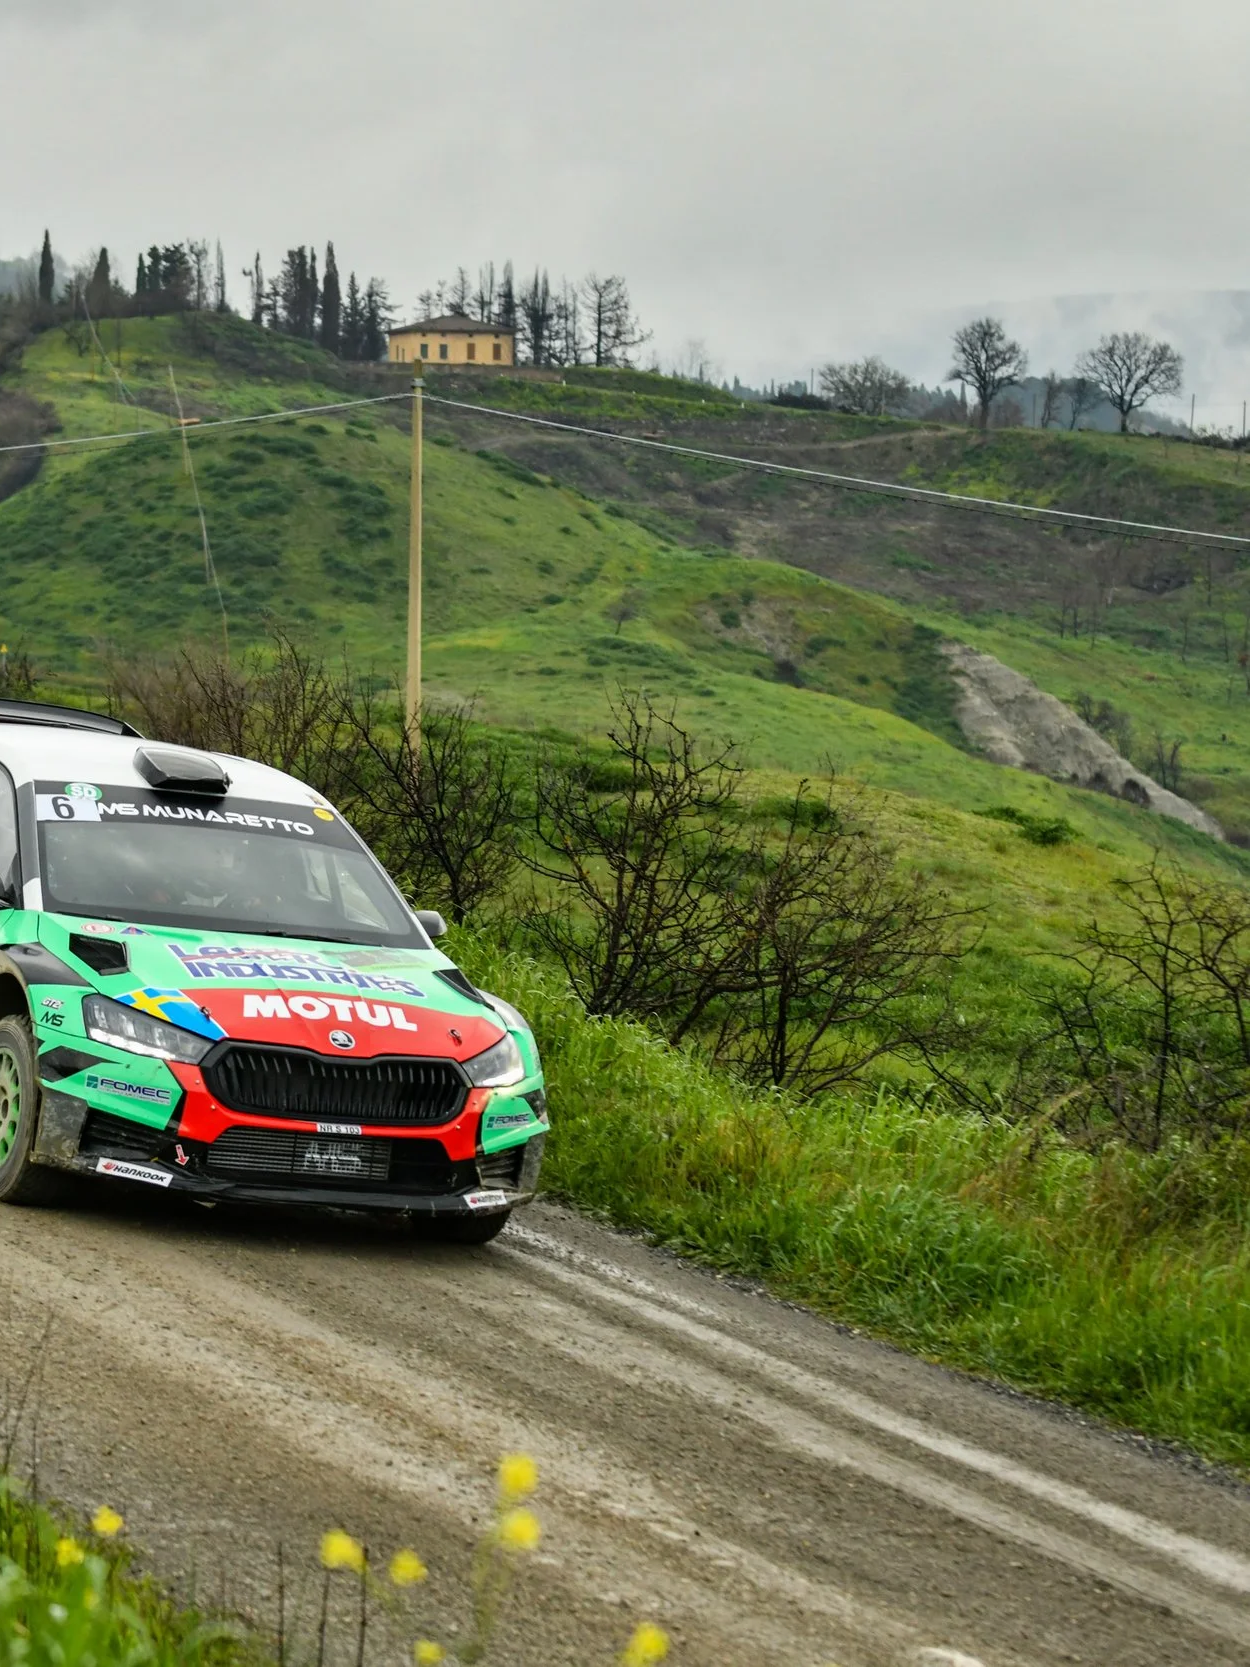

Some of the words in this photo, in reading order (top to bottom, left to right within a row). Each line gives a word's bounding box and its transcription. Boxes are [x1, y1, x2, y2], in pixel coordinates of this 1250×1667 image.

[70, 785, 97, 799] SD
[51, 796, 75, 819] 6
[142, 803, 315, 836] MUNARETTO
[183, 961, 425, 998] INDUSTRIES
[40, 1011, 65, 1027] MS
[242, 994, 418, 1032] MOTUL
[100, 1078, 171, 1100] FOMEC
[319, 1124, 333, 1133] NR
[335, 1125, 342, 1133] S
[345, 1126, 360, 1134] 103
